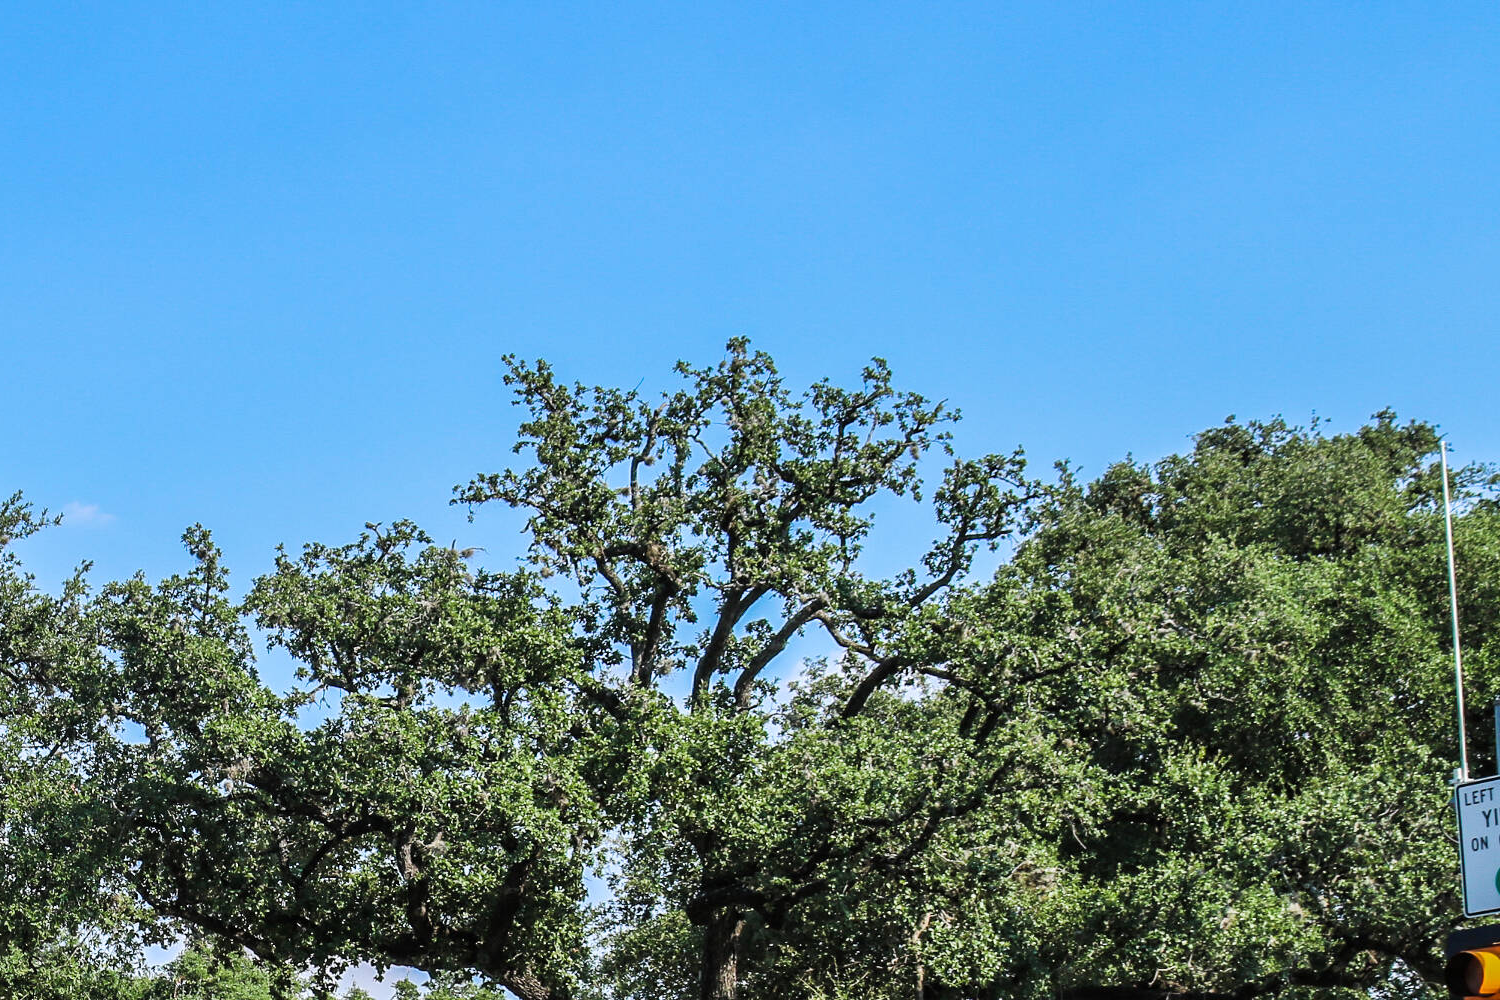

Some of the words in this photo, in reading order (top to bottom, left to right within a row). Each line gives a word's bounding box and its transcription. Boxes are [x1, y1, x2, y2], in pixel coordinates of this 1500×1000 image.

[1464, 787, 1494, 806] LEFT
[1482, 807, 1500, 828] YI
[1471, 835, 1489, 852] ON
